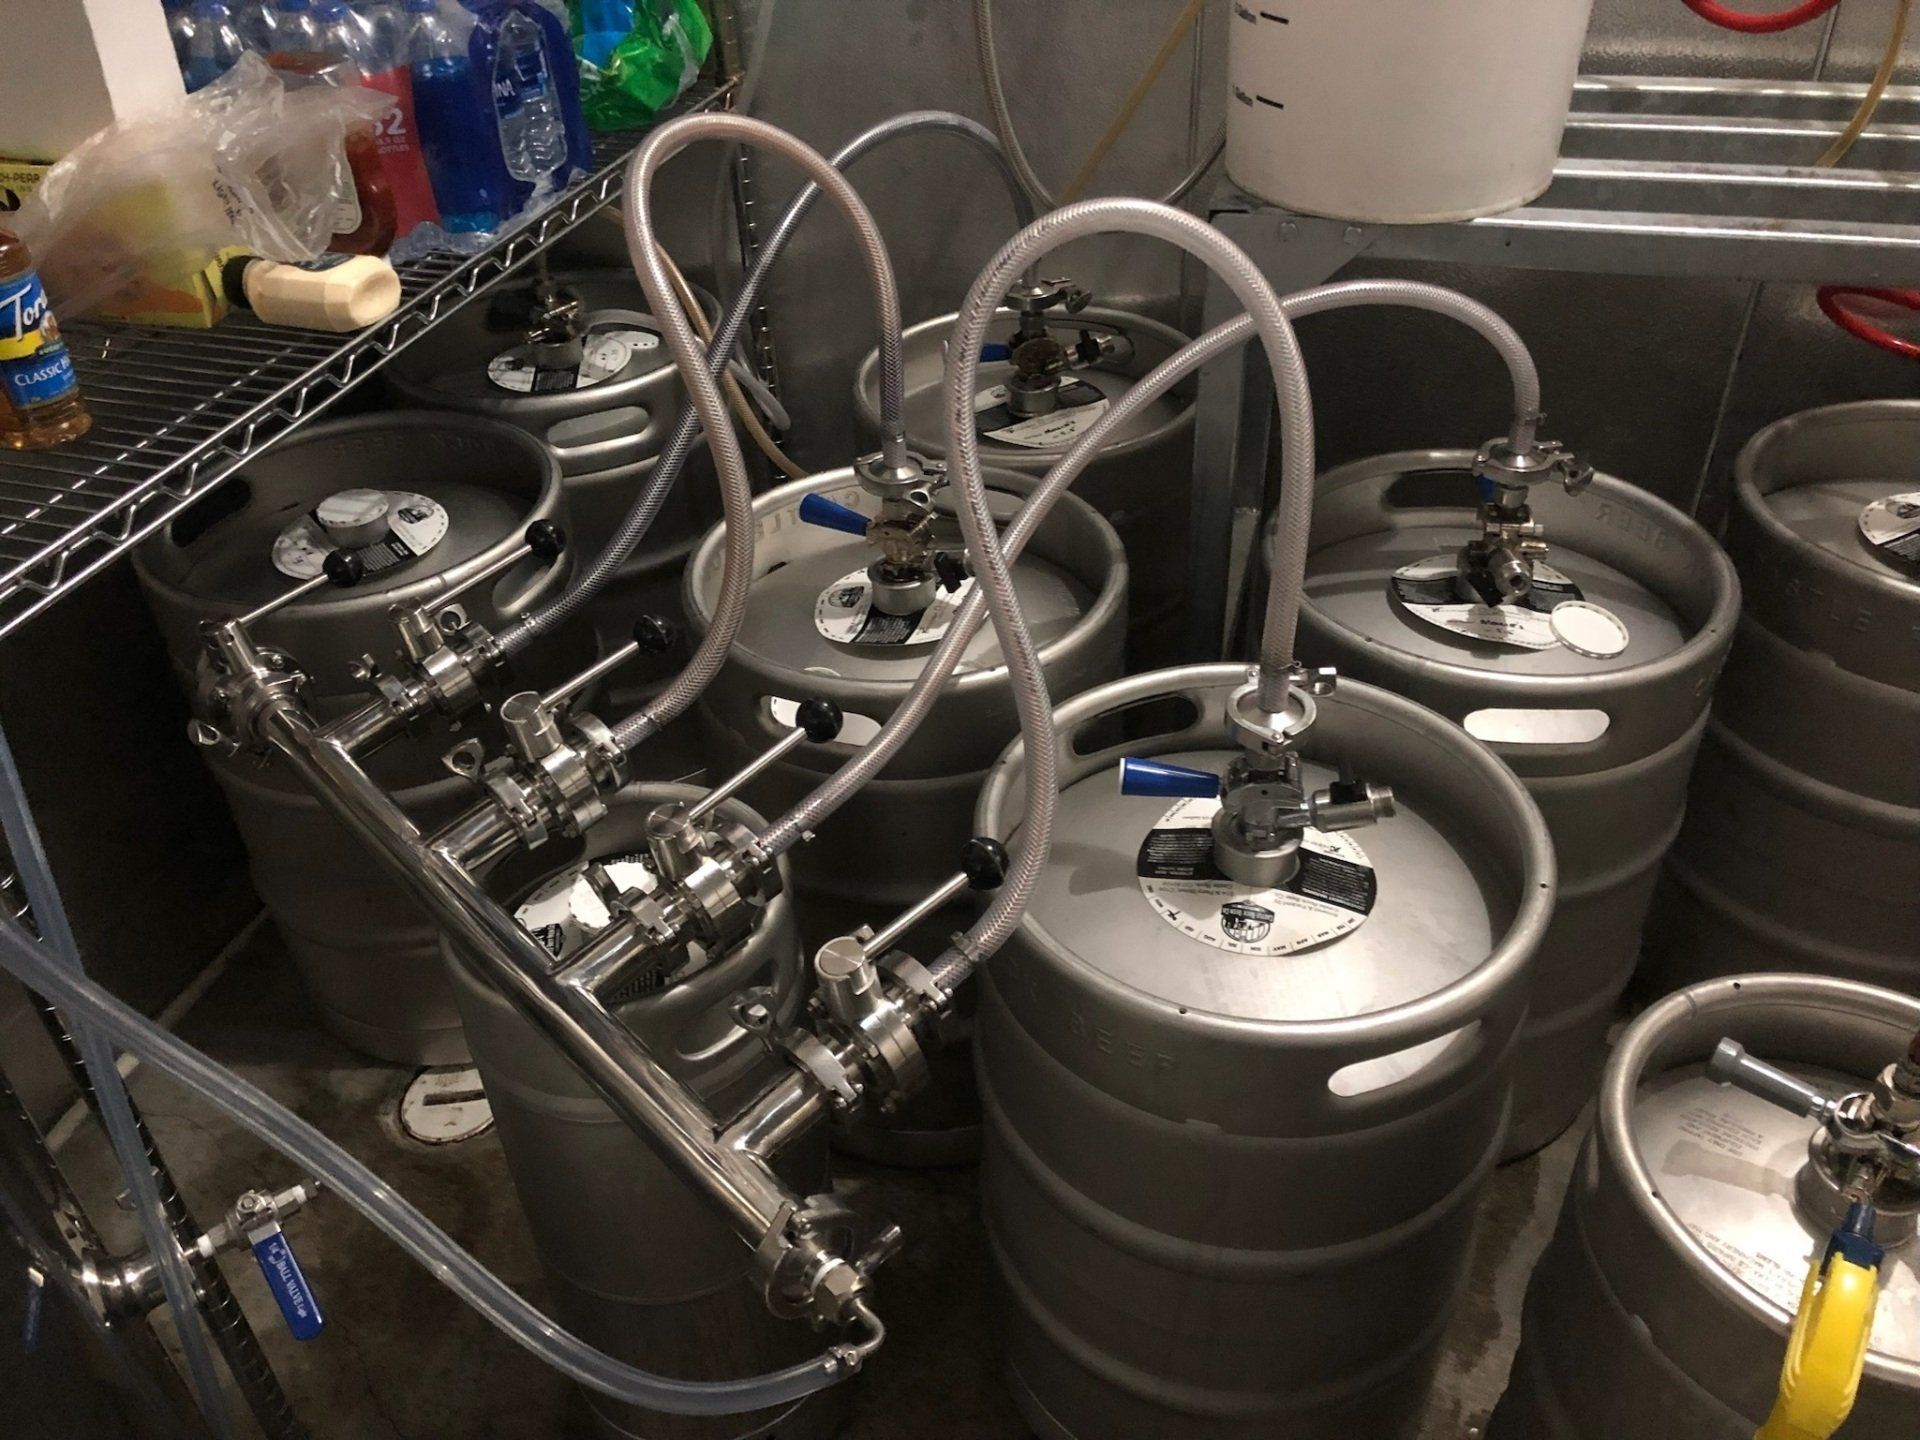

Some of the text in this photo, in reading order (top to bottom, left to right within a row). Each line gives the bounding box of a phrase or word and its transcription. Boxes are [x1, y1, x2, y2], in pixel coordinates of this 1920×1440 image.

[14, 363, 63, 387] CLASSIC
[275, 1260, 293, 1283] BALL
[286, 1279, 305, 1307] VALVE
